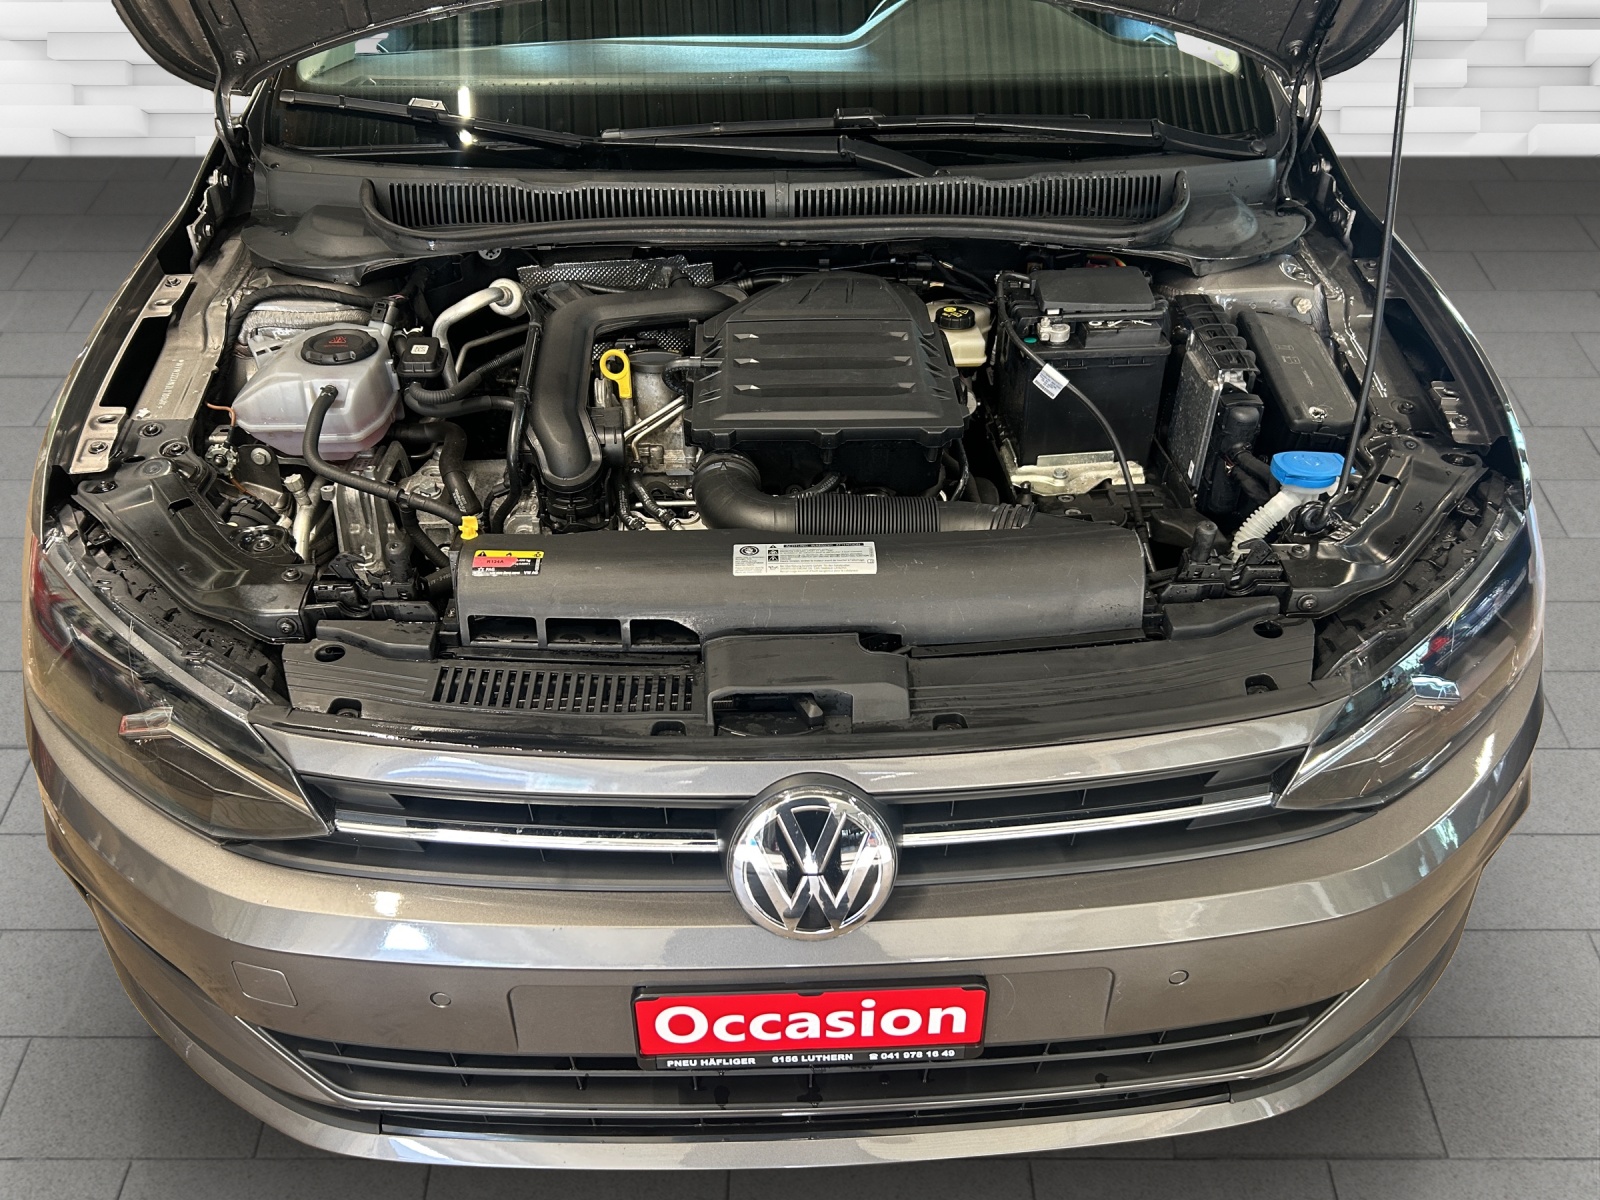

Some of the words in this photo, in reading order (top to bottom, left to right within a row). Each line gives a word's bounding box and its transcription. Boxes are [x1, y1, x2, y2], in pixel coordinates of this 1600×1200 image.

[654, 998, 967, 1044] Occasion
[666, 1059, 698, 1067] PNEU
[700, 1057, 756, 1066] HÄFLIGER
[771, 1055, 799, 1064] 6156
[801, 1053, 854, 1063] LUTHERN
[880, 1052, 900, 1060] 041
[903, 1051, 923, 1059] 978
[925, 1050, 939, 1058] 16
[941, 1049, 956, 1058] 49
